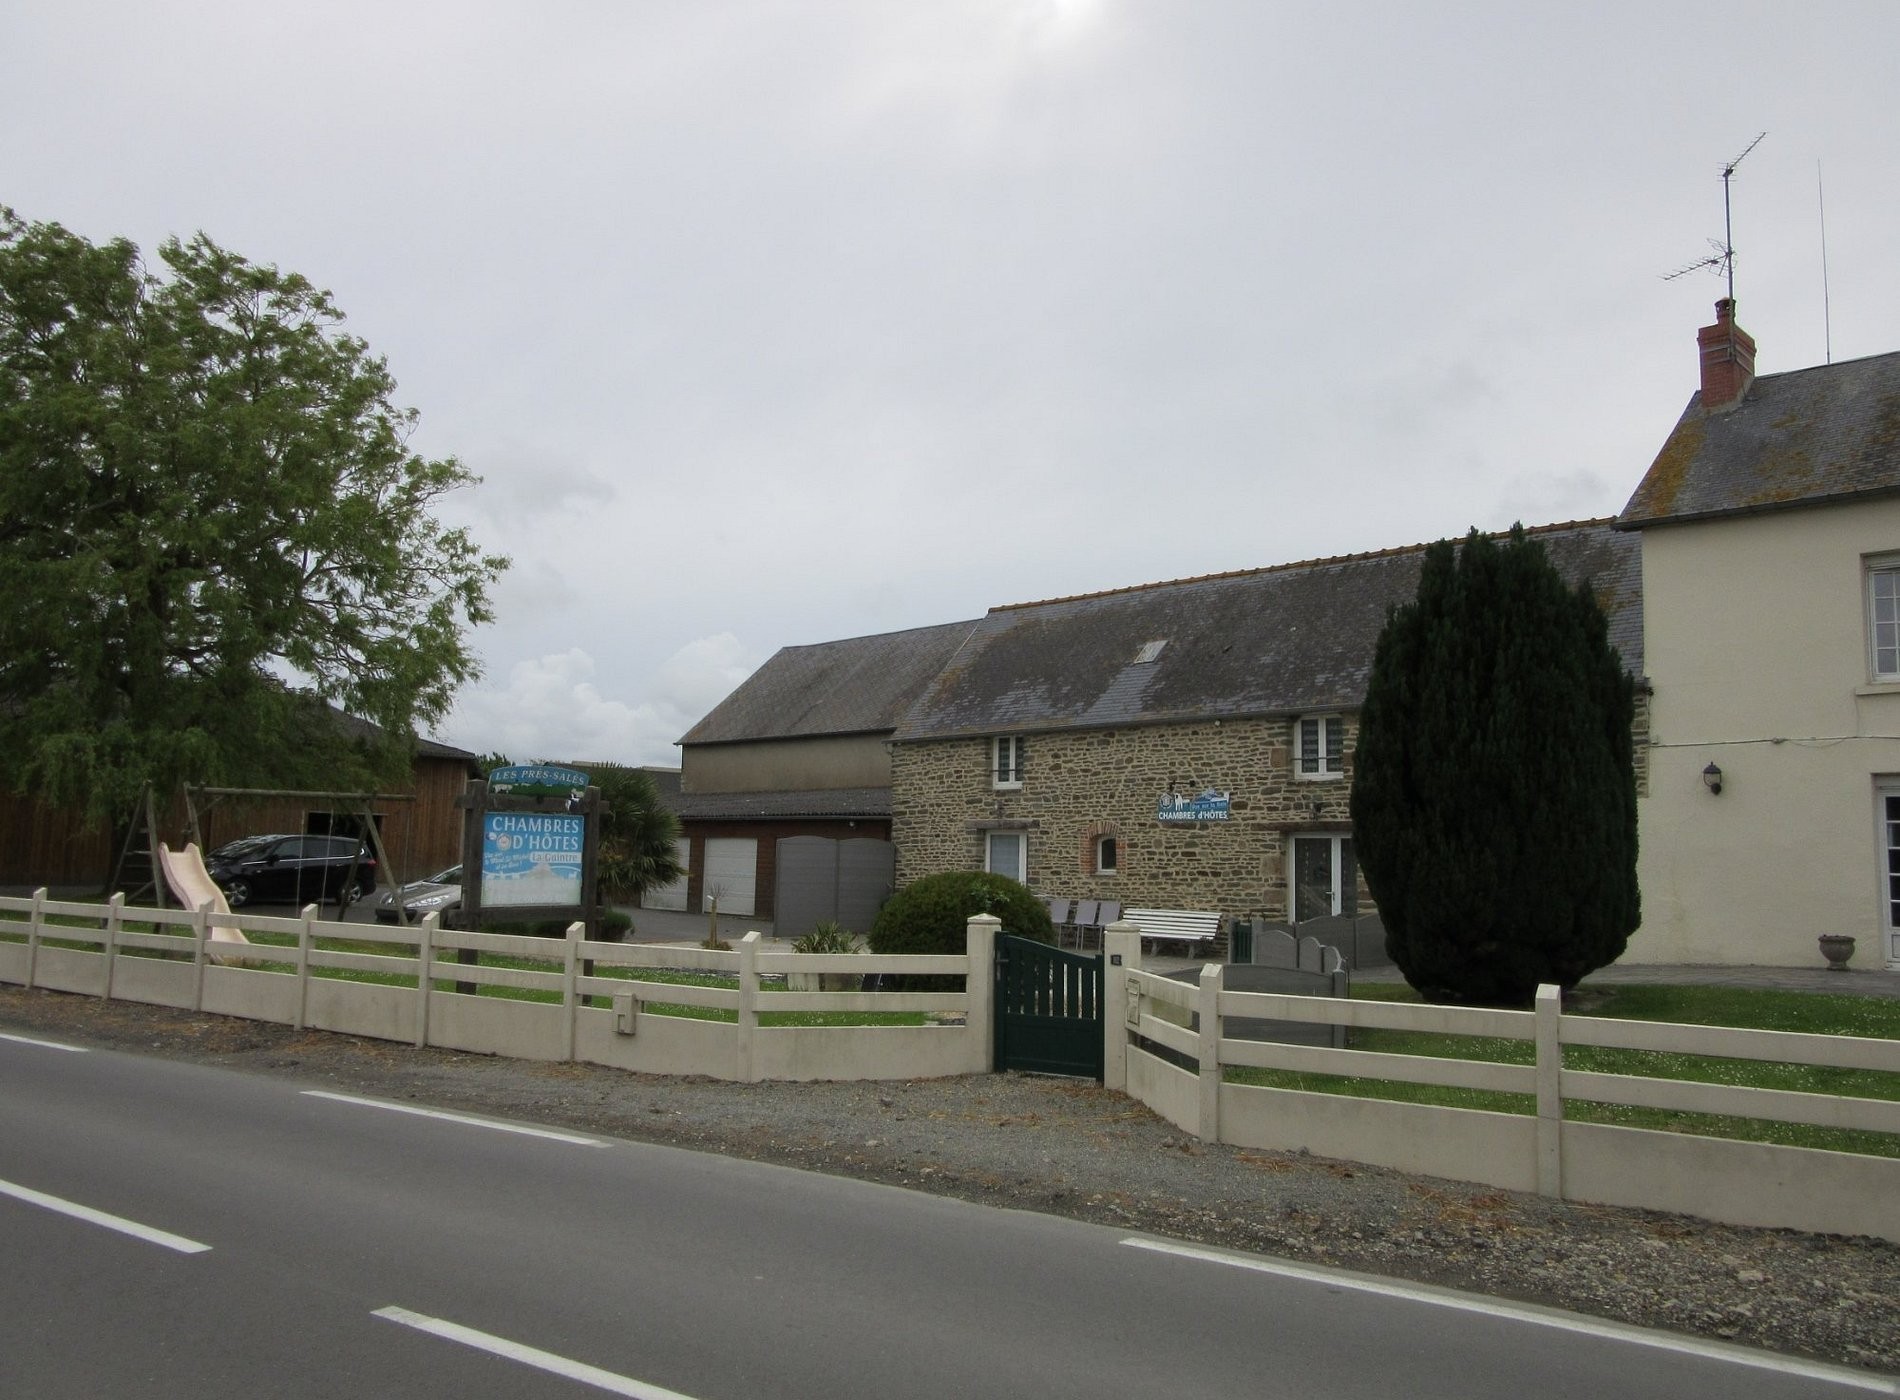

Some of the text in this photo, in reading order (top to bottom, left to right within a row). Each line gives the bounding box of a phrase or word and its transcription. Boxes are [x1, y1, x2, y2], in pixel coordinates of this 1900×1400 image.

[495, 770, 517, 780] LES
[1158, 809, 1228, 820] CHAMBRES d'HÔTES
[492, 816, 579, 833] CHAMBRES
[513, 832, 579, 850] D'HÔTES
